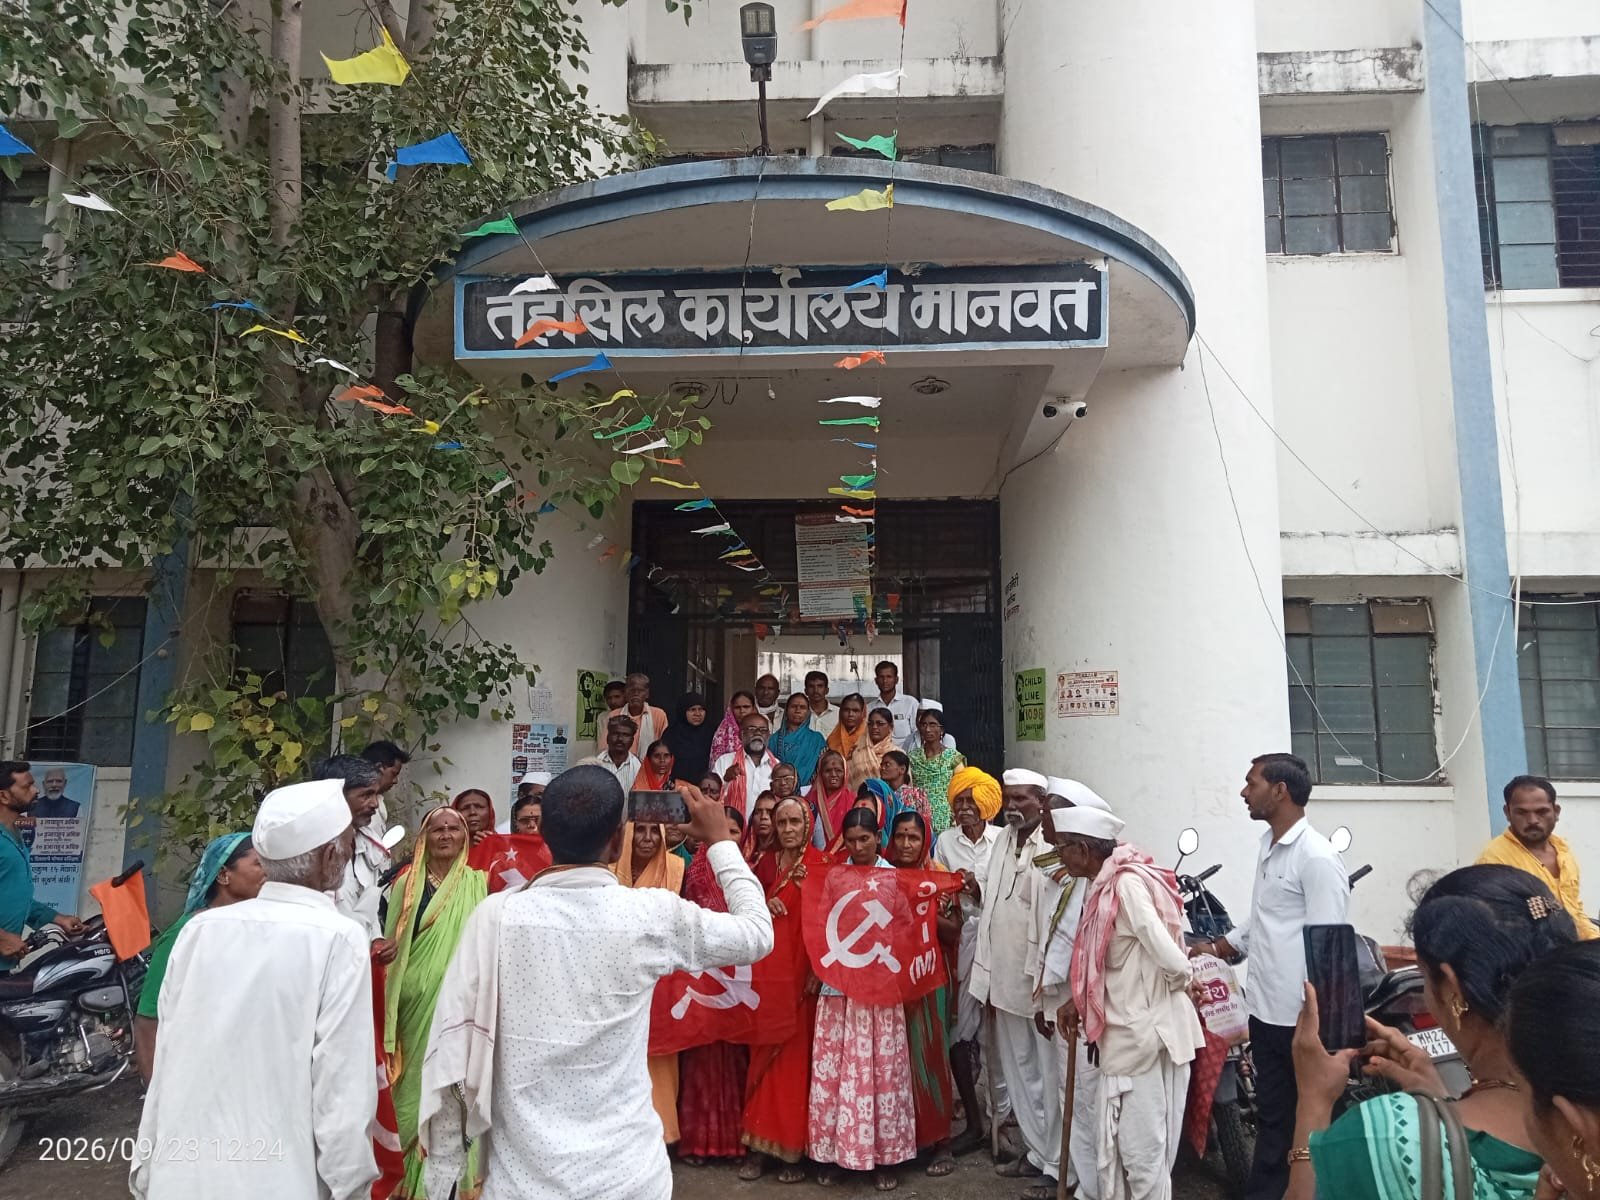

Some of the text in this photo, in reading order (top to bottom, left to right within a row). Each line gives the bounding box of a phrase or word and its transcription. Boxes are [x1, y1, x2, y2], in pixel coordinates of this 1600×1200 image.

[673, 266, 904, 342] कार्यालय
[910, 280, 1097, 335] मानवत
[1024, 676, 1042, 687] CHILD
[1024, 691, 1040, 701] LINE
[1025, 708, 1044, 721] 1098
[1416, 1029, 1447, 1045] MH22
